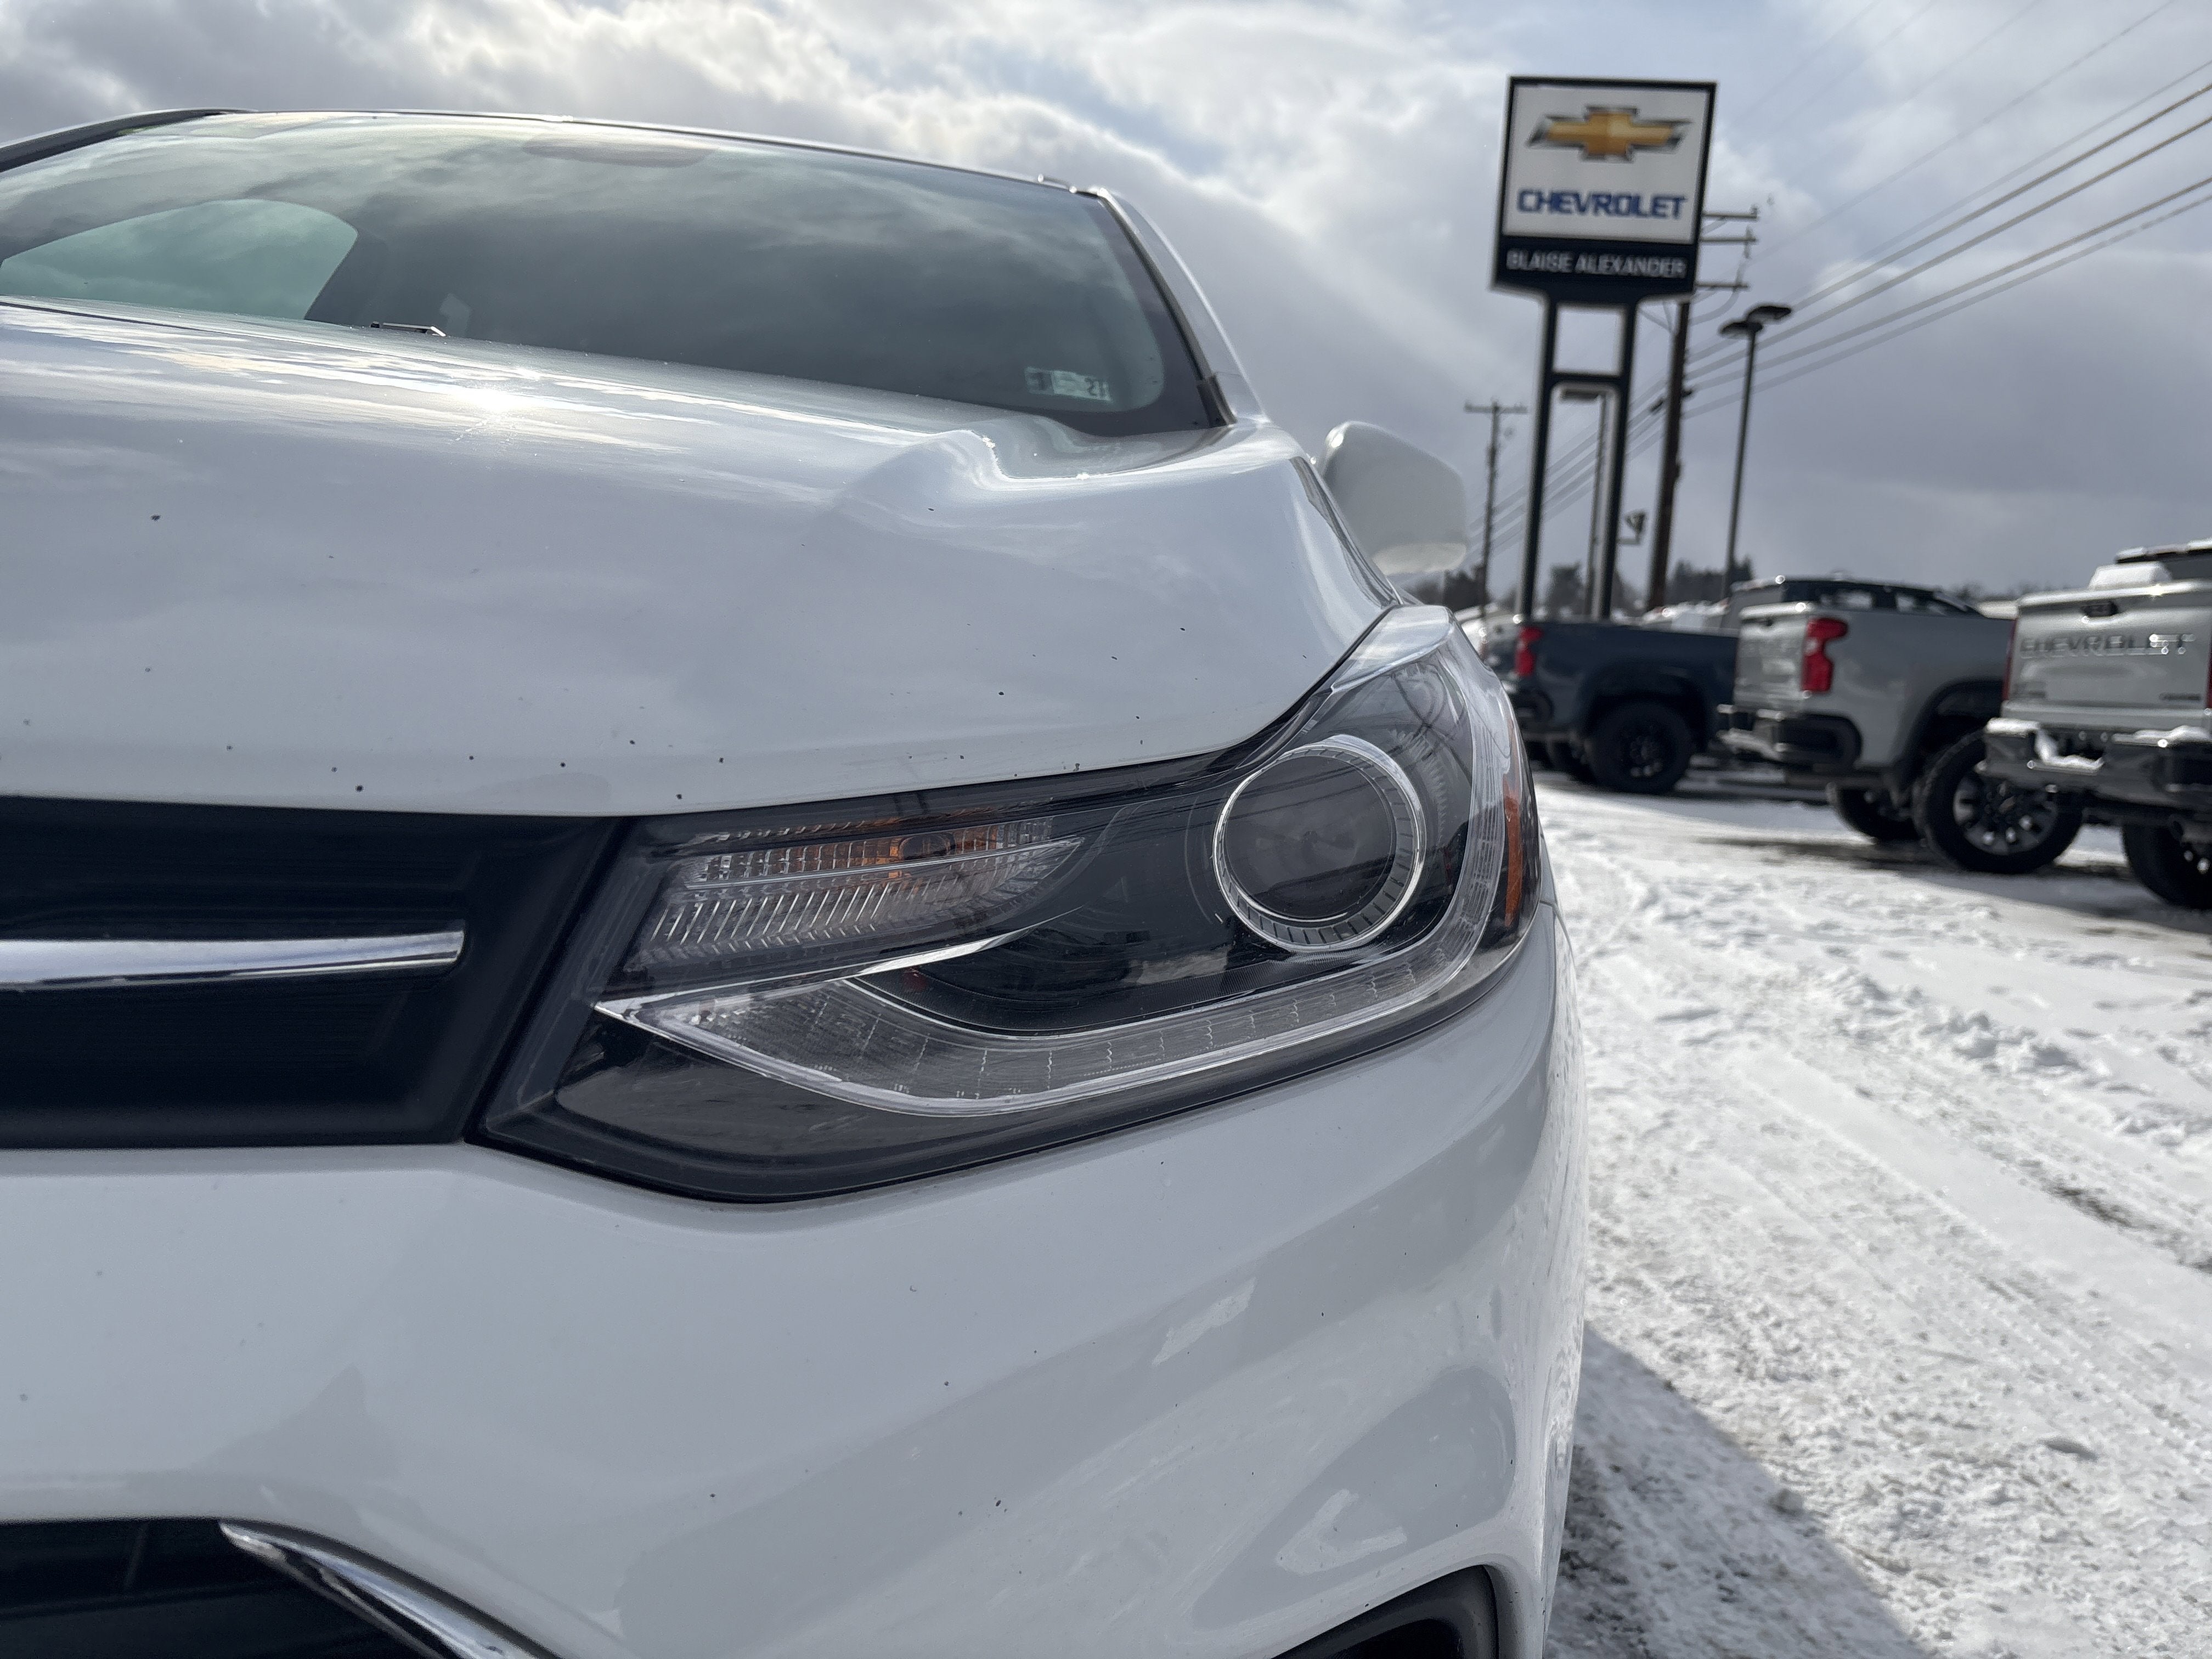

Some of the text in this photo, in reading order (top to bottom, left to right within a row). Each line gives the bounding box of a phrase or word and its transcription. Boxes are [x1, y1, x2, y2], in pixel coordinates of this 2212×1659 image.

[1516, 188, 1686, 219] CHEVROLET
[1505, 248, 1688, 278] BLAISE ALEXANDER
